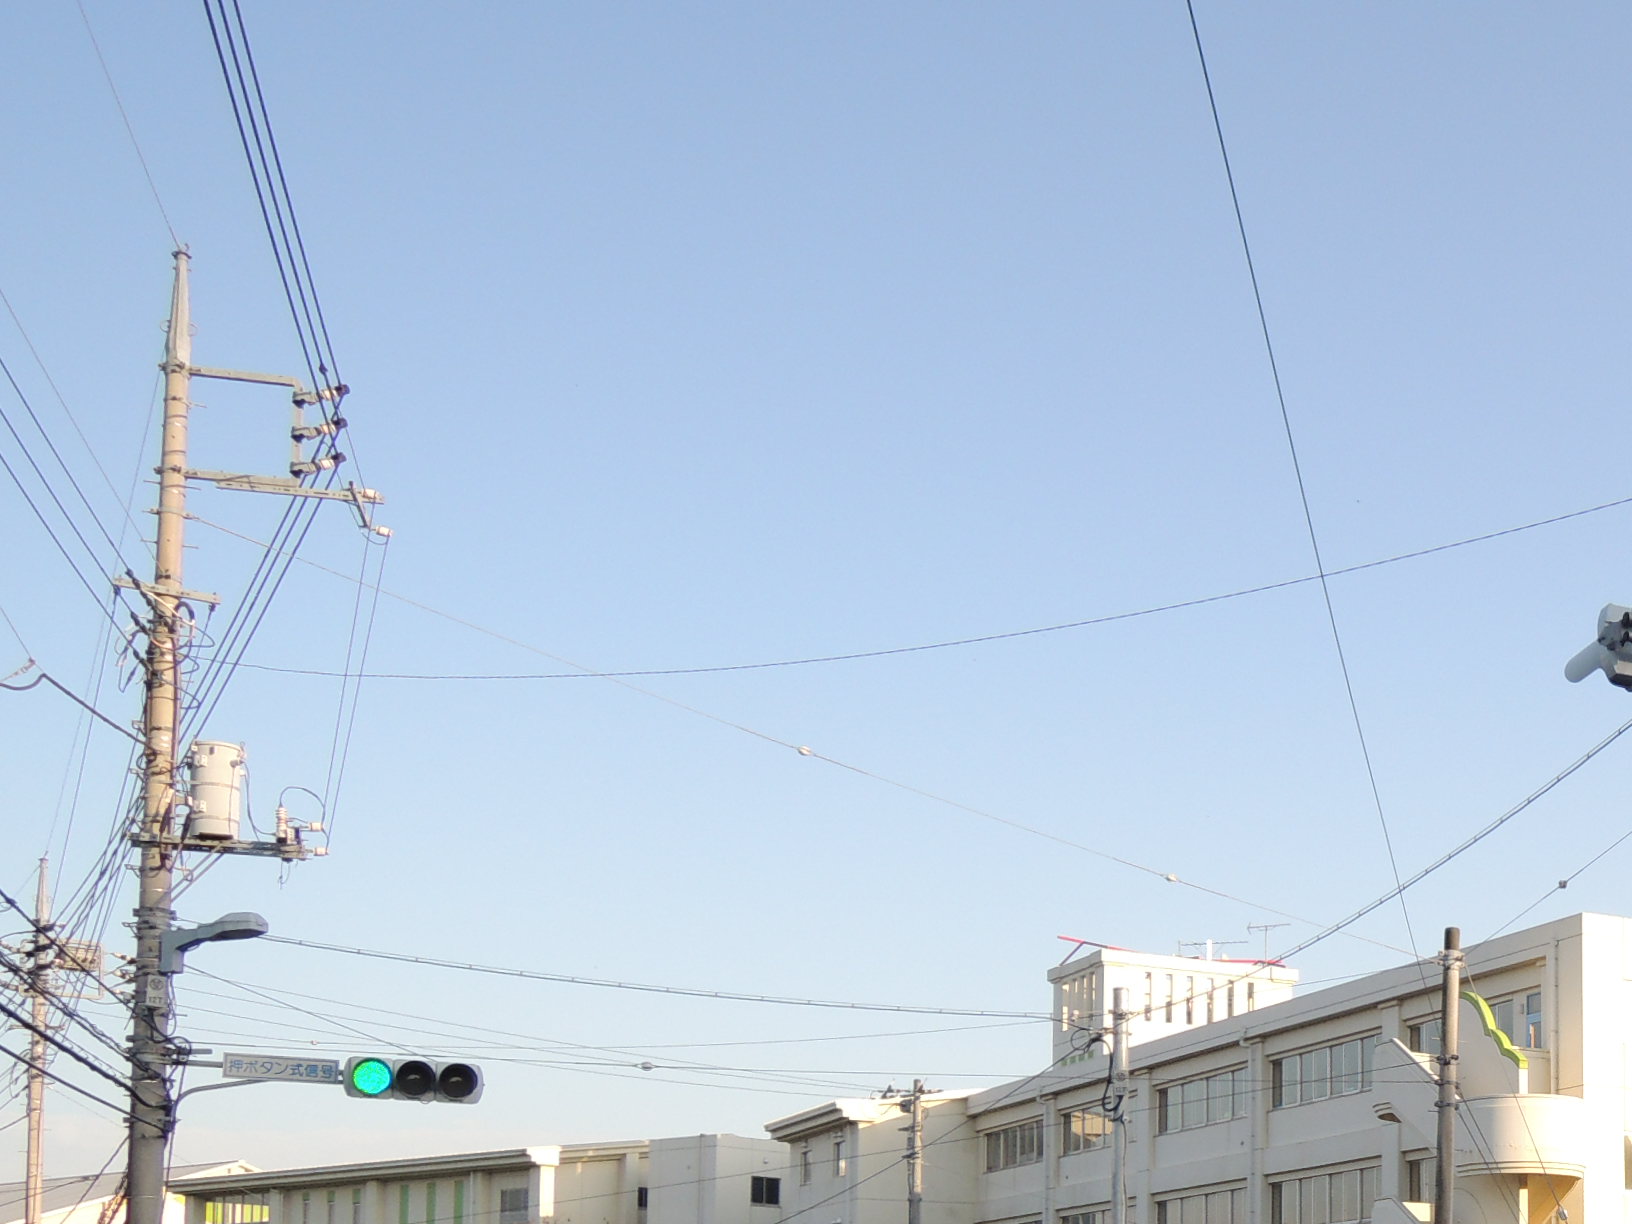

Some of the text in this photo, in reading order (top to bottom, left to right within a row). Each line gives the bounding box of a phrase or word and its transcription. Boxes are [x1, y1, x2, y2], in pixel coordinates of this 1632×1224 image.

[228, 1060, 334, 1079] 押ボタン式信号
